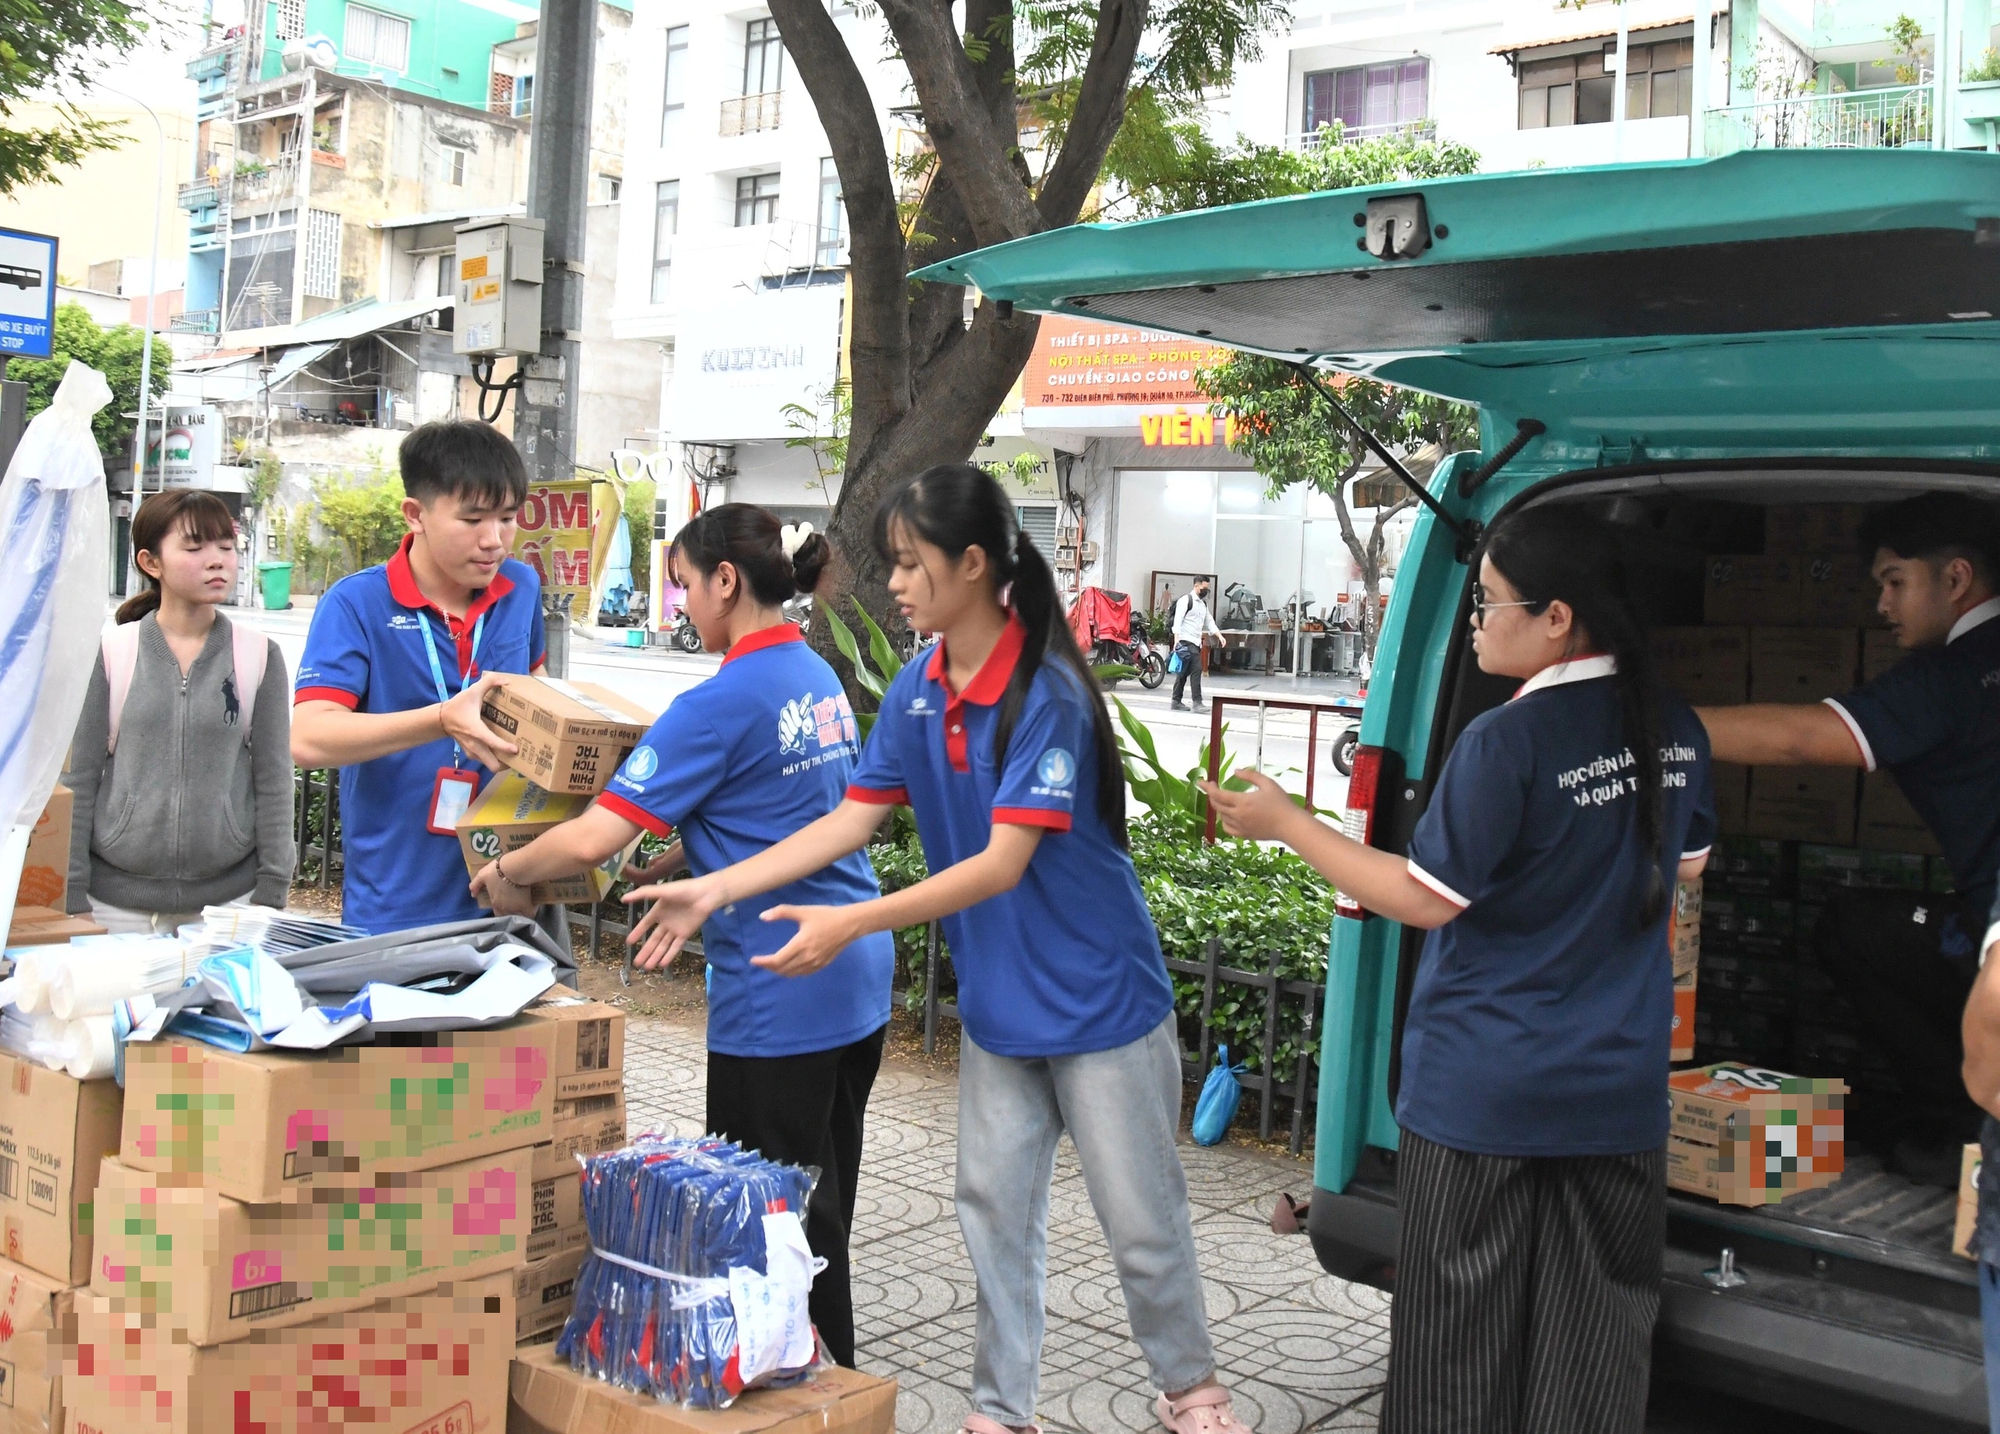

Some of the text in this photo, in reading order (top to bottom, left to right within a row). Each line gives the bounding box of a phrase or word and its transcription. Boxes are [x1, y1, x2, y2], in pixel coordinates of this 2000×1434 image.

[11, 321, 23, 334] XE
[24, 322, 47, 337] BUÝT
[1, 336, 25, 349] STOP
[1050, 332, 1085, 348] THIẾT
[1088, 334, 1101, 348] BỊ
[1104, 333, 1129, 346] SPA
[1049, 353, 1073, 369] NỘI
[1077, 350, 1109, 366] THẤT
[1113, 353, 1138, 366] SPA
[1106, 371, 1142, 384] GIAO
[1145, 367, 1190, 382] CÔNG
[1062, 393, 1073, 402] 732
[516, 488, 588, 531] ƠM
[508, 536, 589, 586] ẤM
[1711, 561, 1733, 582] C2
[1810, 559, 1832, 581] C2
[782, 762, 800, 776] HÃY
[1558, 766, 1587, 789] HỌC
[1587, 755, 1618, 779] VIỆN
[569, 773, 595, 785] PHIN
[1592, 778, 1625, 806] QUẢN
[472, 832, 501, 857] C2
[1684, 1103, 1715, 1118] HANDLE
[1677, 1114, 1697, 1125] WITH
[31, 1178, 53, 1202] 130090
[533, 1187, 555, 1201] PHIN
